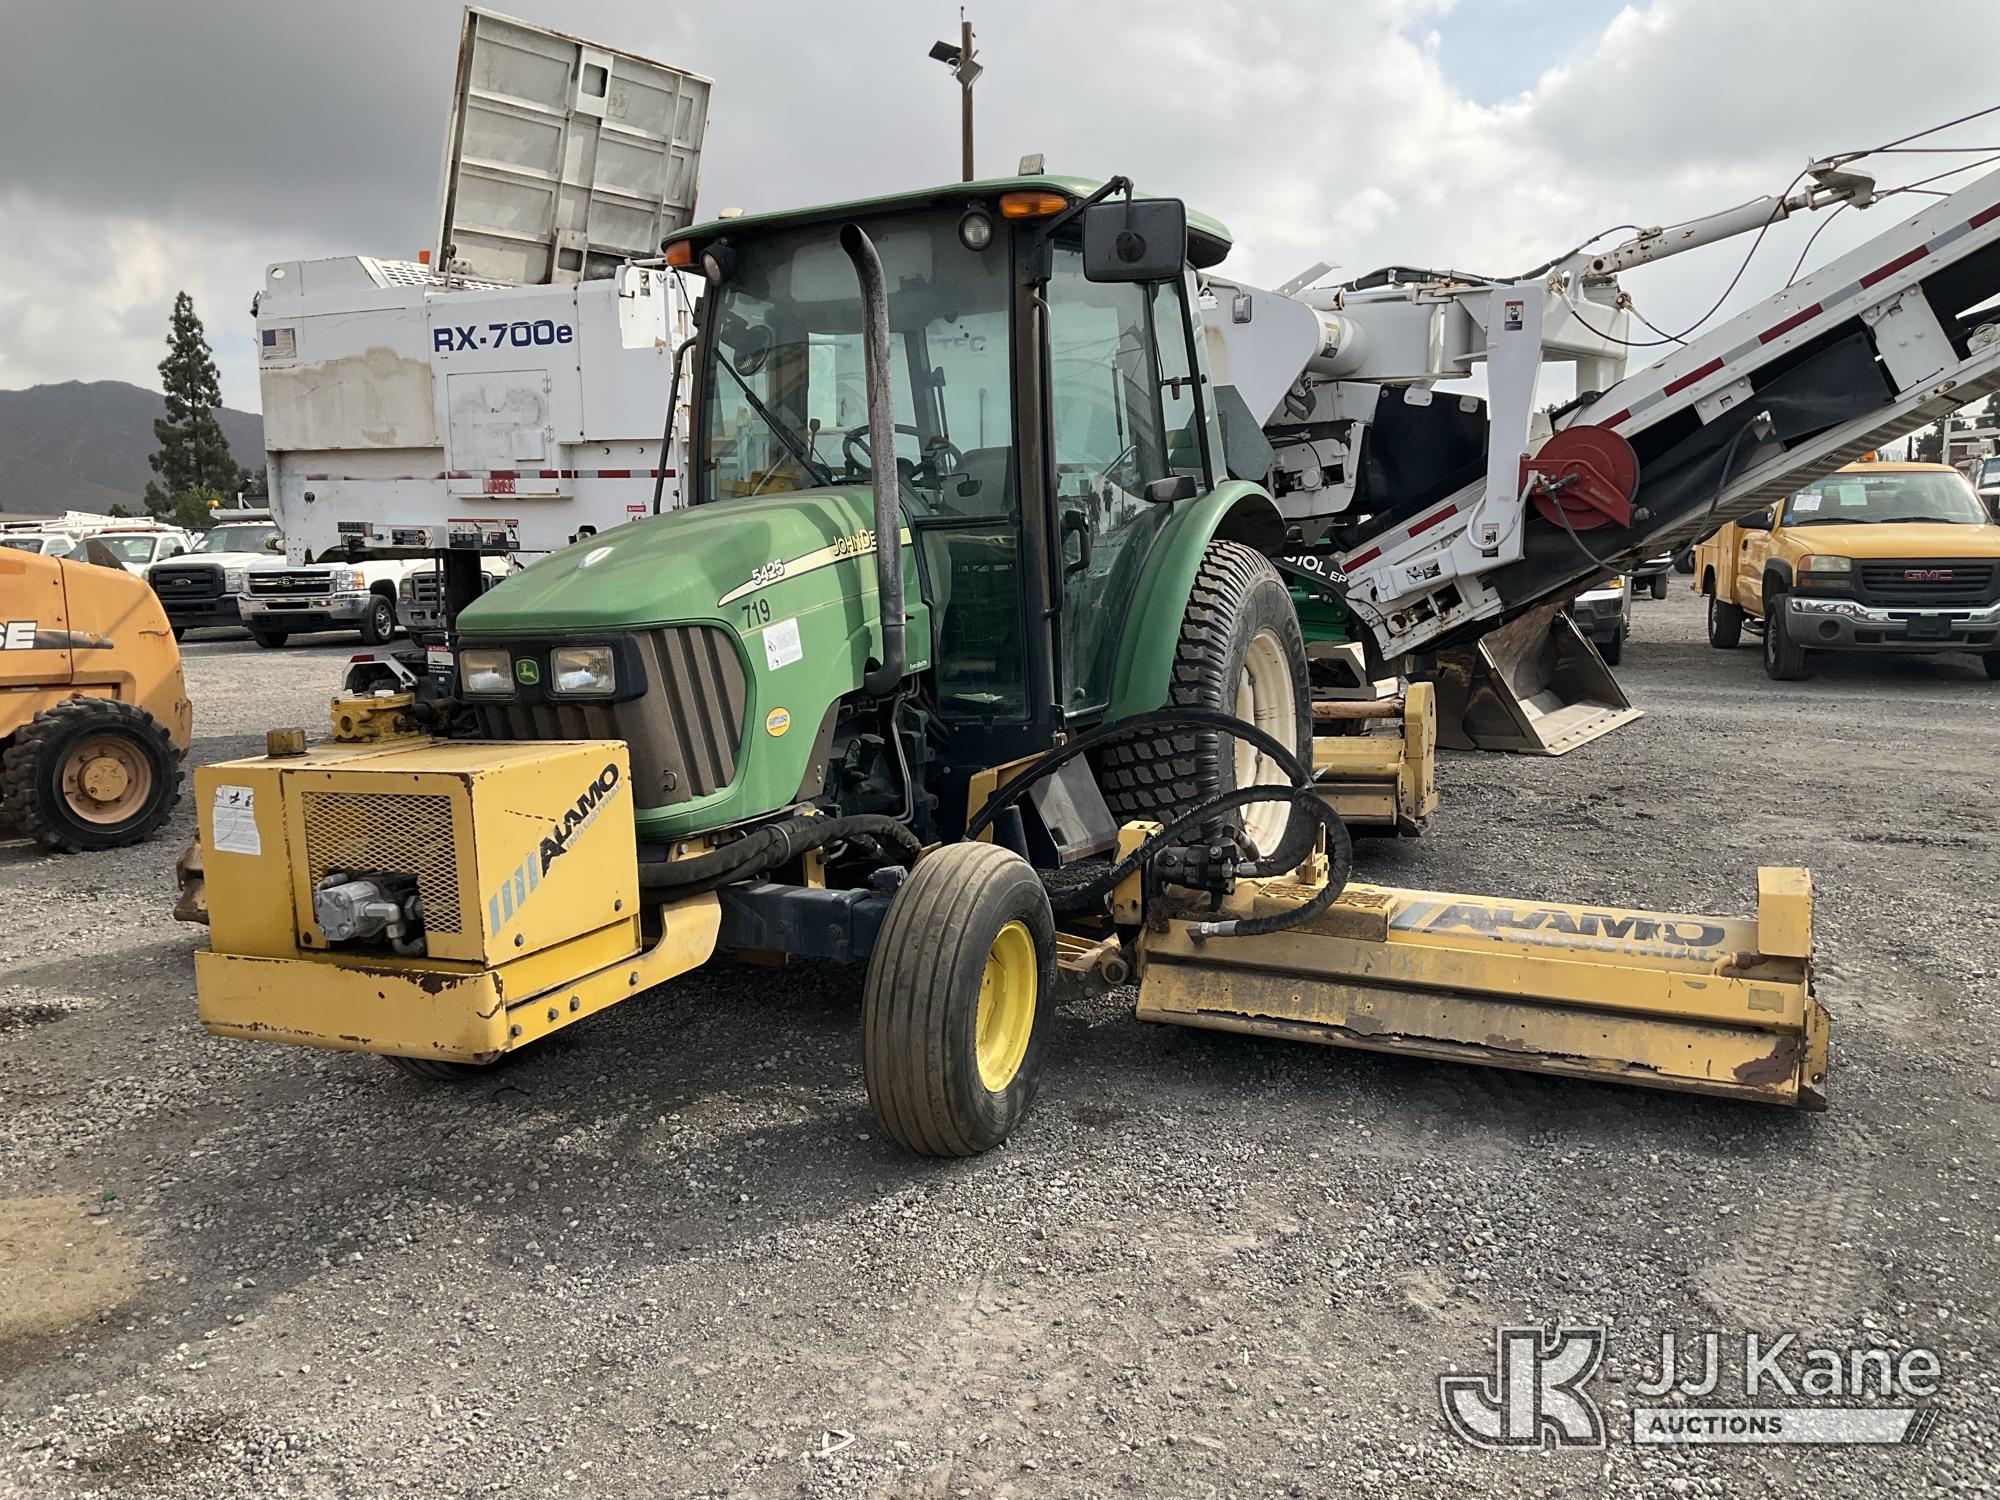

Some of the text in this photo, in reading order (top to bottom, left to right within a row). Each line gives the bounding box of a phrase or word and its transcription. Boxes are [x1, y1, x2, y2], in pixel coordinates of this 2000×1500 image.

[433, 319, 573, 352] RX-700e
[833, 533, 862, 556] JOHN
[752, 559, 785, 585] 5425
[1329, 570, 1347, 583] EP
[1904, 569, 1952, 581] GMC
[741, 598, 771, 628] 719
[0, 621, 37, 649] E
[540, 763, 619, 878] ALAMO
[1421, 901, 1725, 946] ALAMO
